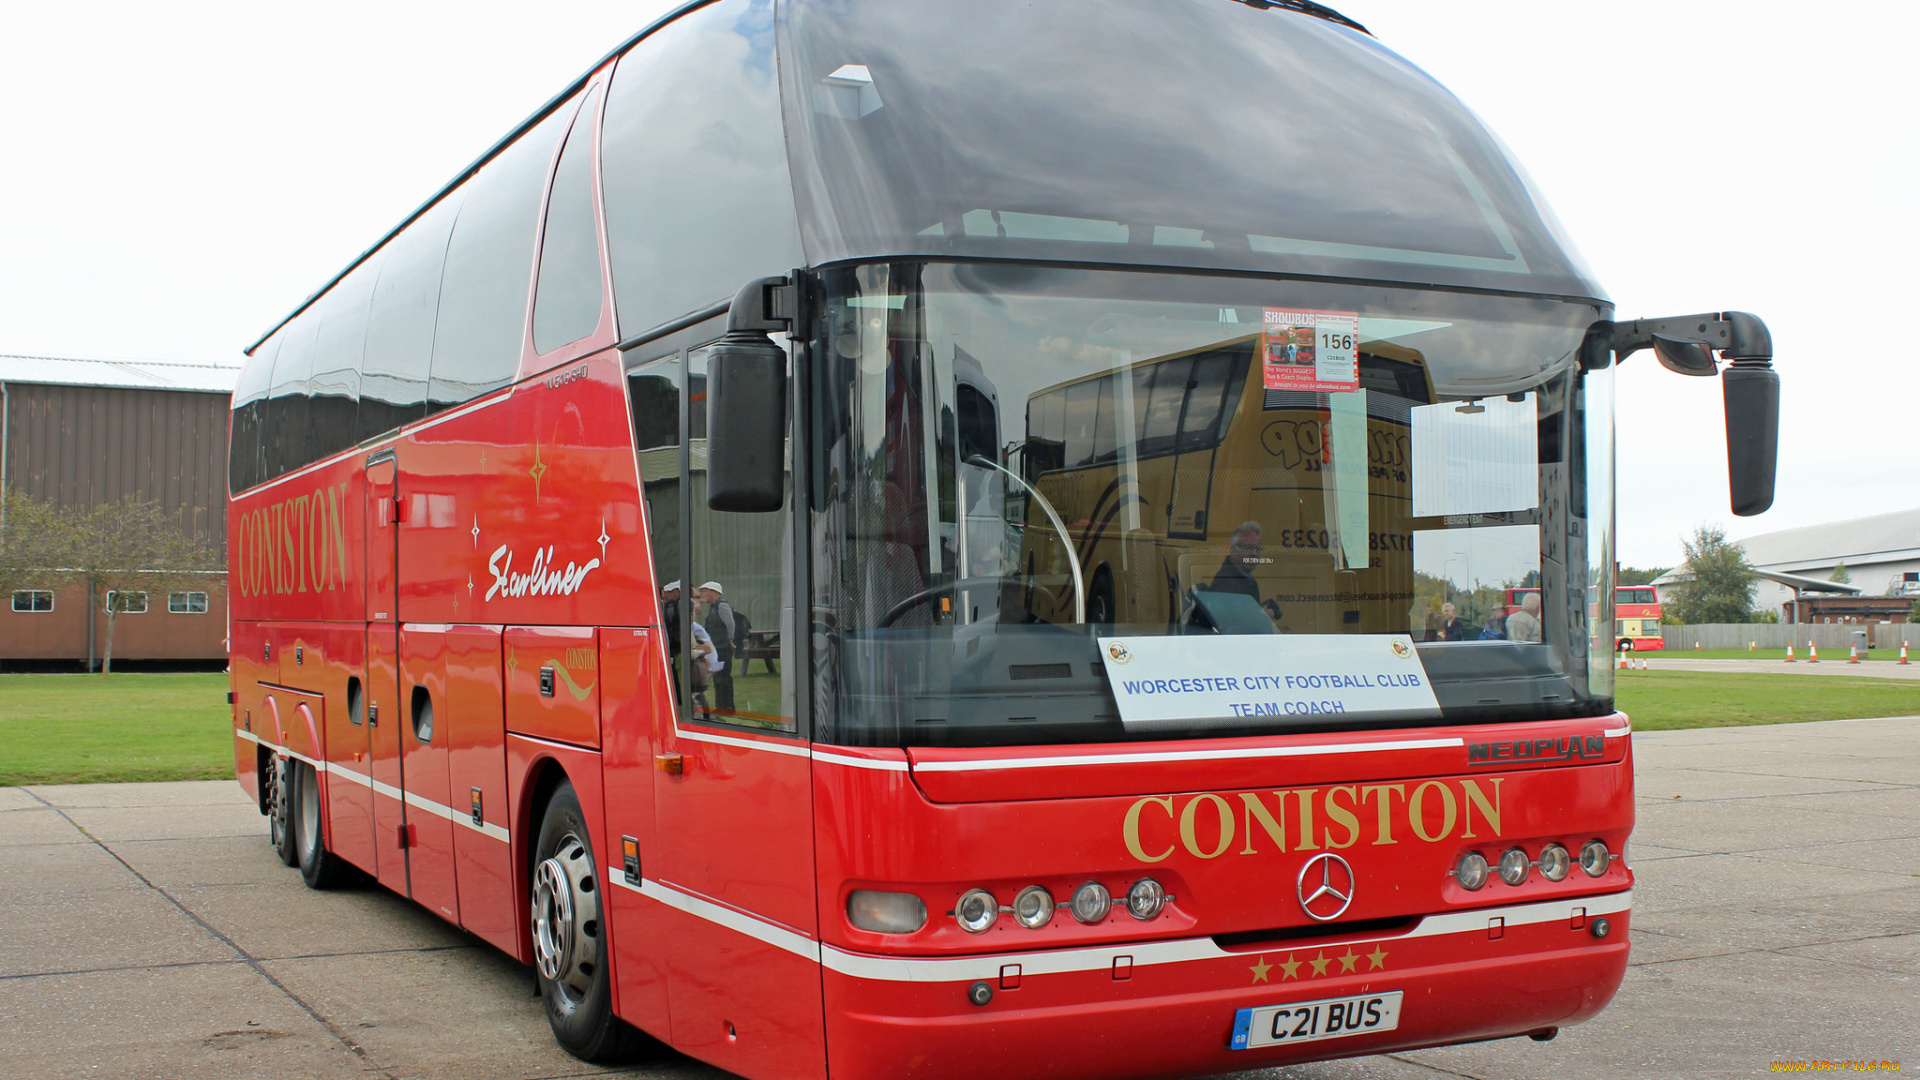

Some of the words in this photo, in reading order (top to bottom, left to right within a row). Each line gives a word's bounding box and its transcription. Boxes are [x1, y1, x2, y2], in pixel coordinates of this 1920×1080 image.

[1265, 311, 1315, 325] SHOWBUS
[1322, 334, 1351, 350] 156
[237, 482, 348, 598] CONISTON
[485, 544, 600, 602] Starliner
[566, 648, 596, 670] CONISTON
[1123, 677, 1240, 695] WORCESTER
[1243, 676, 1280, 690] CITY
[1285, 674, 1375, 689] FOOTBALL
[1376, 674, 1421, 687] CLUB
[1229, 702, 1280, 718] TEAM
[1284, 700, 1345, 716] COACH
[1468, 735, 1604, 763] NEOPLAN
[1122, 777, 1505, 863] CONISTON
[1271, 1006, 1319, 1039] C21
[1326, 998, 1383, 1033] BUS
[1235, 1034, 1246, 1043] GB
